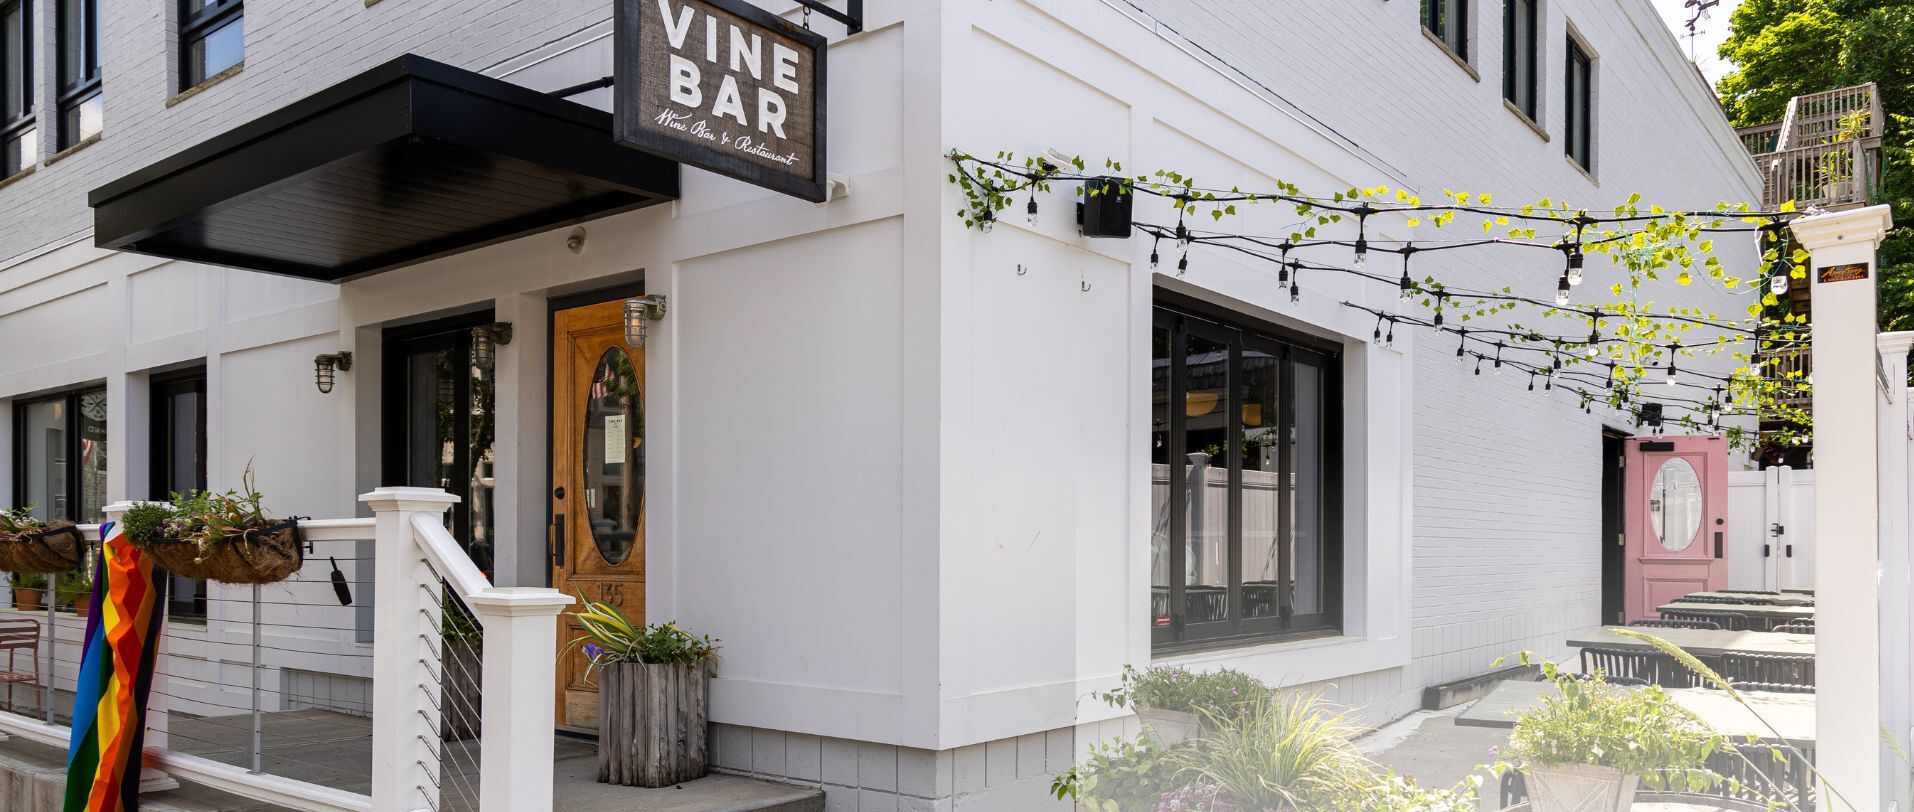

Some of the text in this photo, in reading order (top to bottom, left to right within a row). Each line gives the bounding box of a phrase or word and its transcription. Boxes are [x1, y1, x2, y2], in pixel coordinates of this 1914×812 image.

[657, 0, 799, 94] VINE
[654, 108, 799, 166] Wine Bar & Restaurant
[670, 53, 787, 139] BAR
